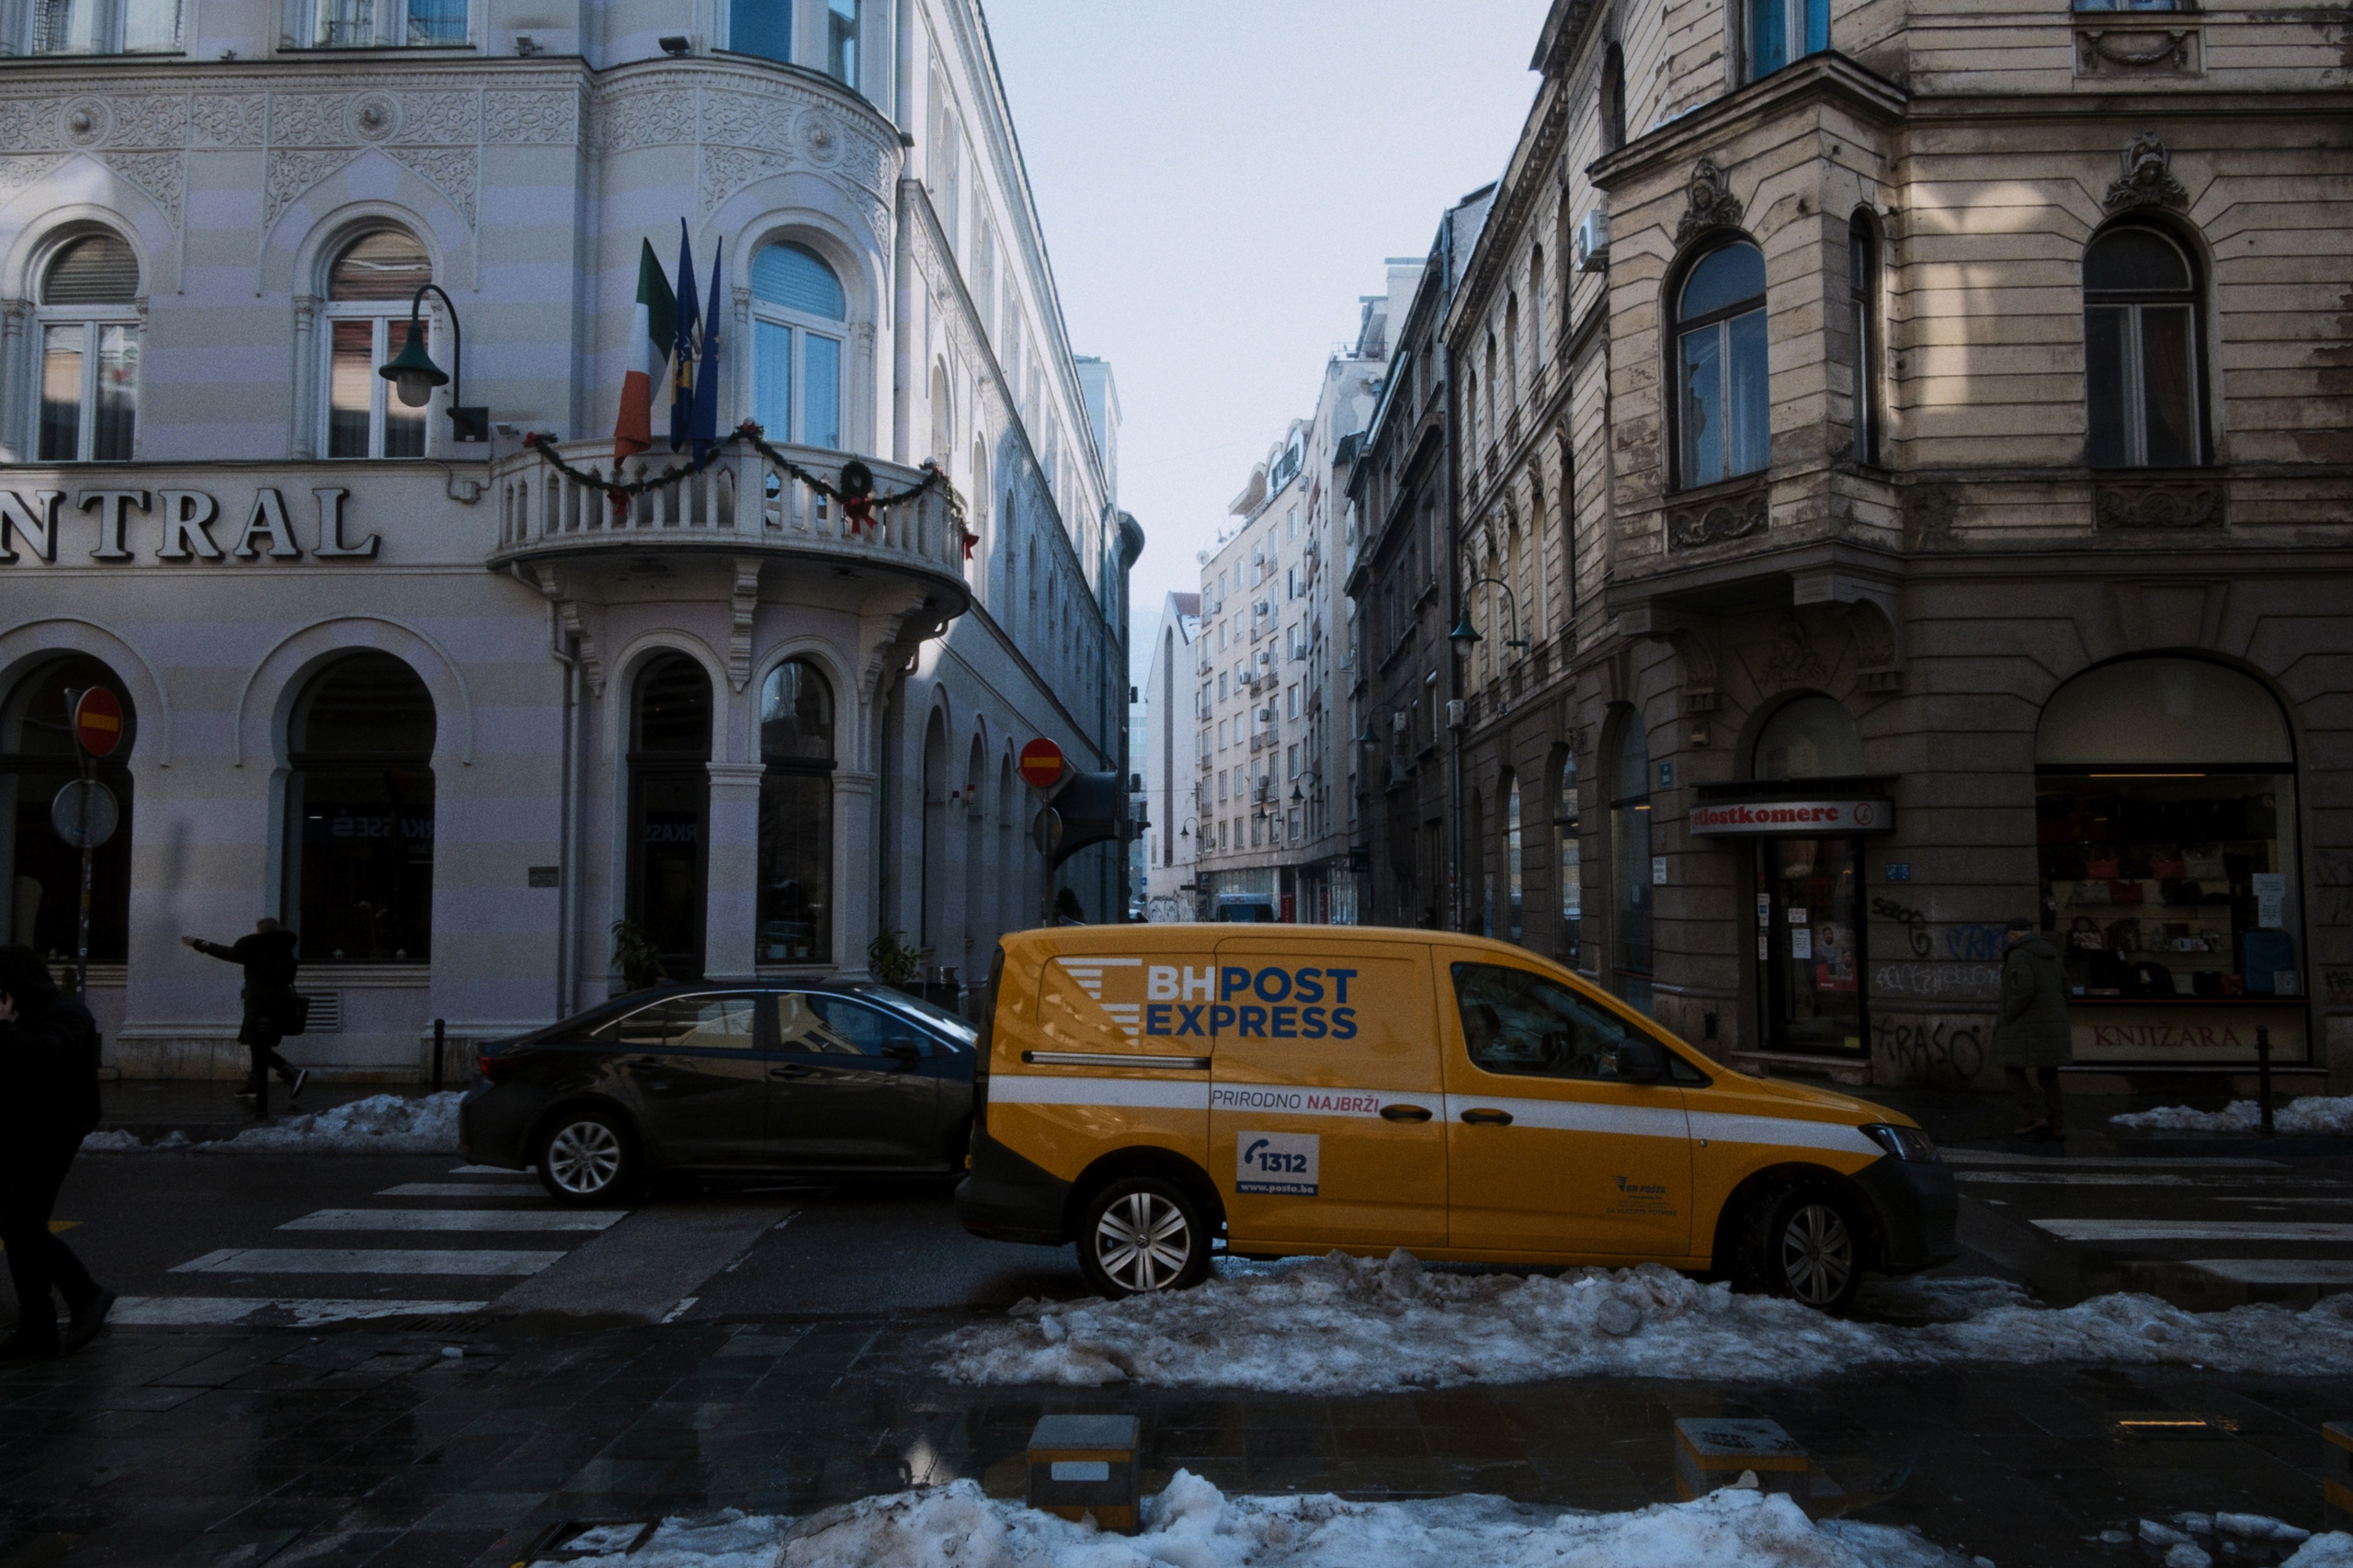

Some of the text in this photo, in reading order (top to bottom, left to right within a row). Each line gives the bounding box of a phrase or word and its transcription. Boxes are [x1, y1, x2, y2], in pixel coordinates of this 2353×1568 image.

[0, 487, 381, 562] NTRAL
[1146, 1004, 1358, 1040] EXPRESS
[2092, 1020, 2243, 1047] KNJIŽARA
[1211, 1090, 1381, 1113] PRIRODNO NAJBRŽI
[1258, 1153, 1307, 1173] 1312
[1241, 1184, 1314, 1194] www.posta.ba
